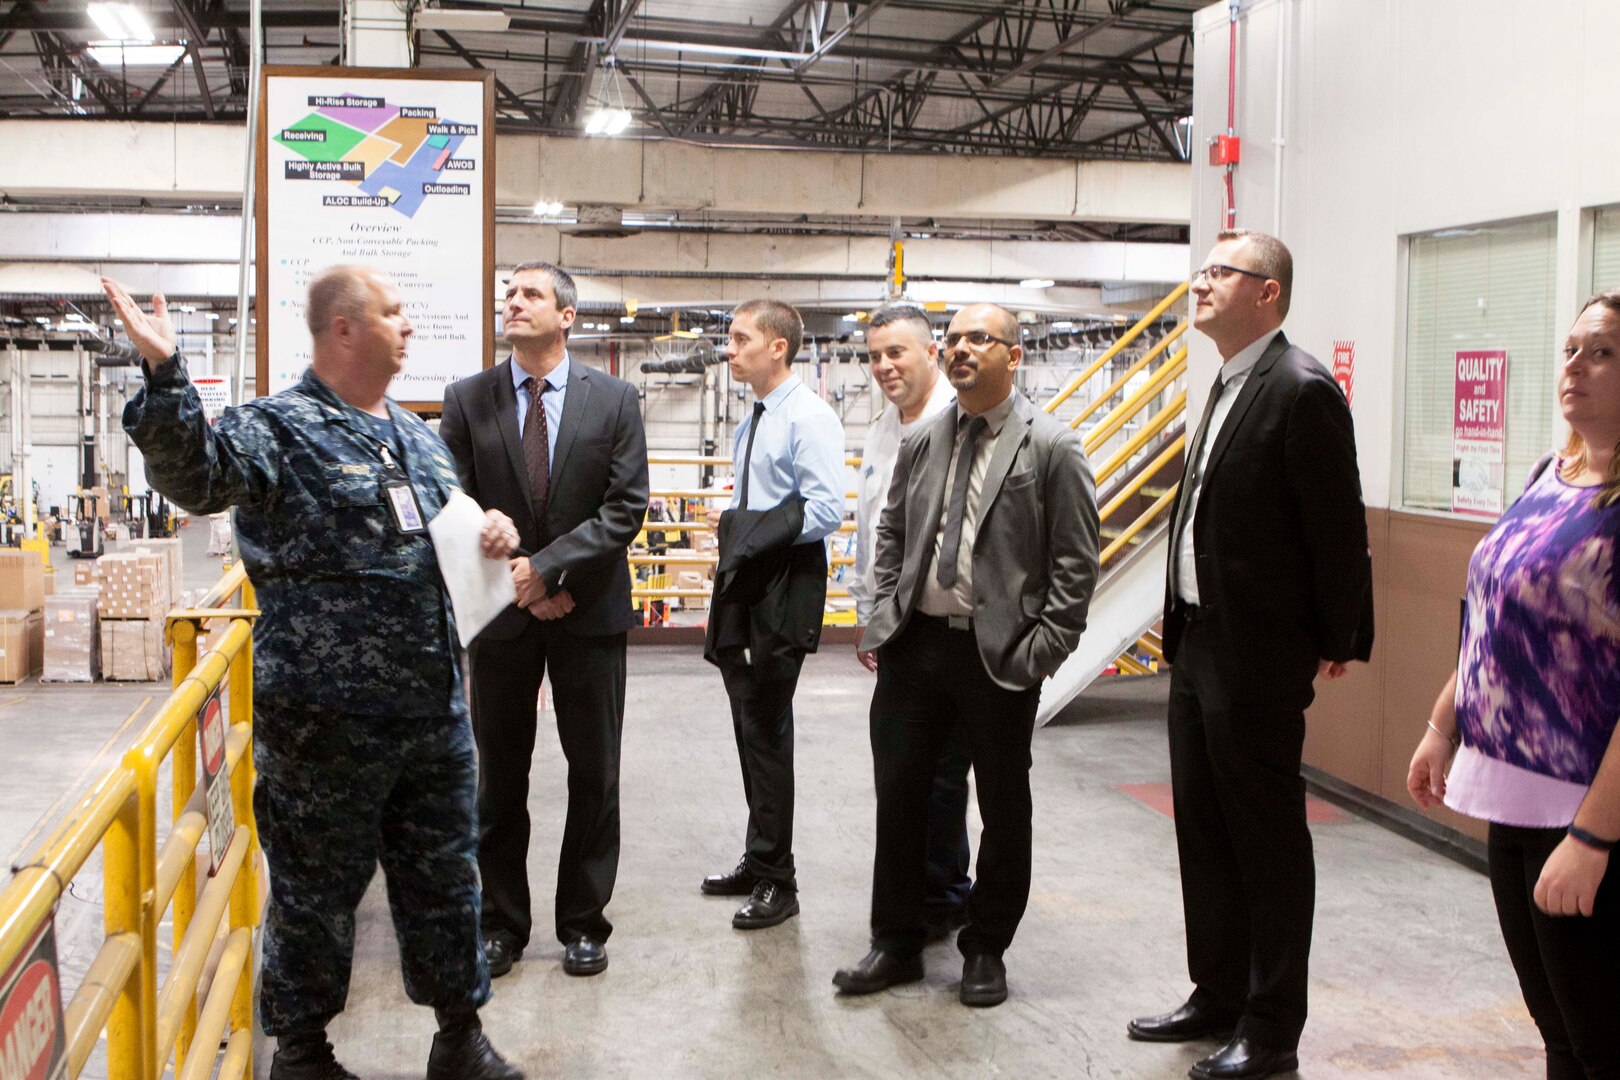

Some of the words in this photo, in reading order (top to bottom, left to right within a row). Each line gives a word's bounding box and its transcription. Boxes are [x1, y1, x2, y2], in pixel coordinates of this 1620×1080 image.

[315, 97, 345, 106] Hi-Rise
[346, 98, 378, 108] Storage
[402, 108, 434, 119] Packing
[428, 125, 449, 134] Walk
[450, 126, 457, 134] &
[458, 126, 476, 135] Pick
[283, 131, 324, 142] Receiving
[288, 161, 314, 172] Highly
[316, 162, 341, 171] Active
[343, 162, 361, 171] Bulk
[309, 171, 341, 180] Storage
[424, 185, 468, 195] Outloading
[351, 197, 386, 206] Build-Up
[350, 222, 402, 233] Overview
[406, 238, 439, 247] Packing
[342, 248, 357, 257] And
[359, 249, 378, 257] Bulk
[381, 249, 412, 258] Storage
[290, 258, 310, 266] CCP
[388, 270, 419, 278] Stations
[397, 281, 433, 289] Conveyor
[422, 313, 451, 321] Systems
[454, 313, 469, 321] And
[433, 323, 453, 331] Items
[450, 333, 466, 341] Bulk
[1337, 351, 1351, 364] FIRE
[1457, 357, 1504, 382] QUALITY
[403, 373, 447, 384] Processing
[1473, 383, 1487, 396] and
[1459, 398, 1500, 423] SAFETY
[1455, 426, 1464, 439] go
[0, 974, 55, 1080] ANGER
